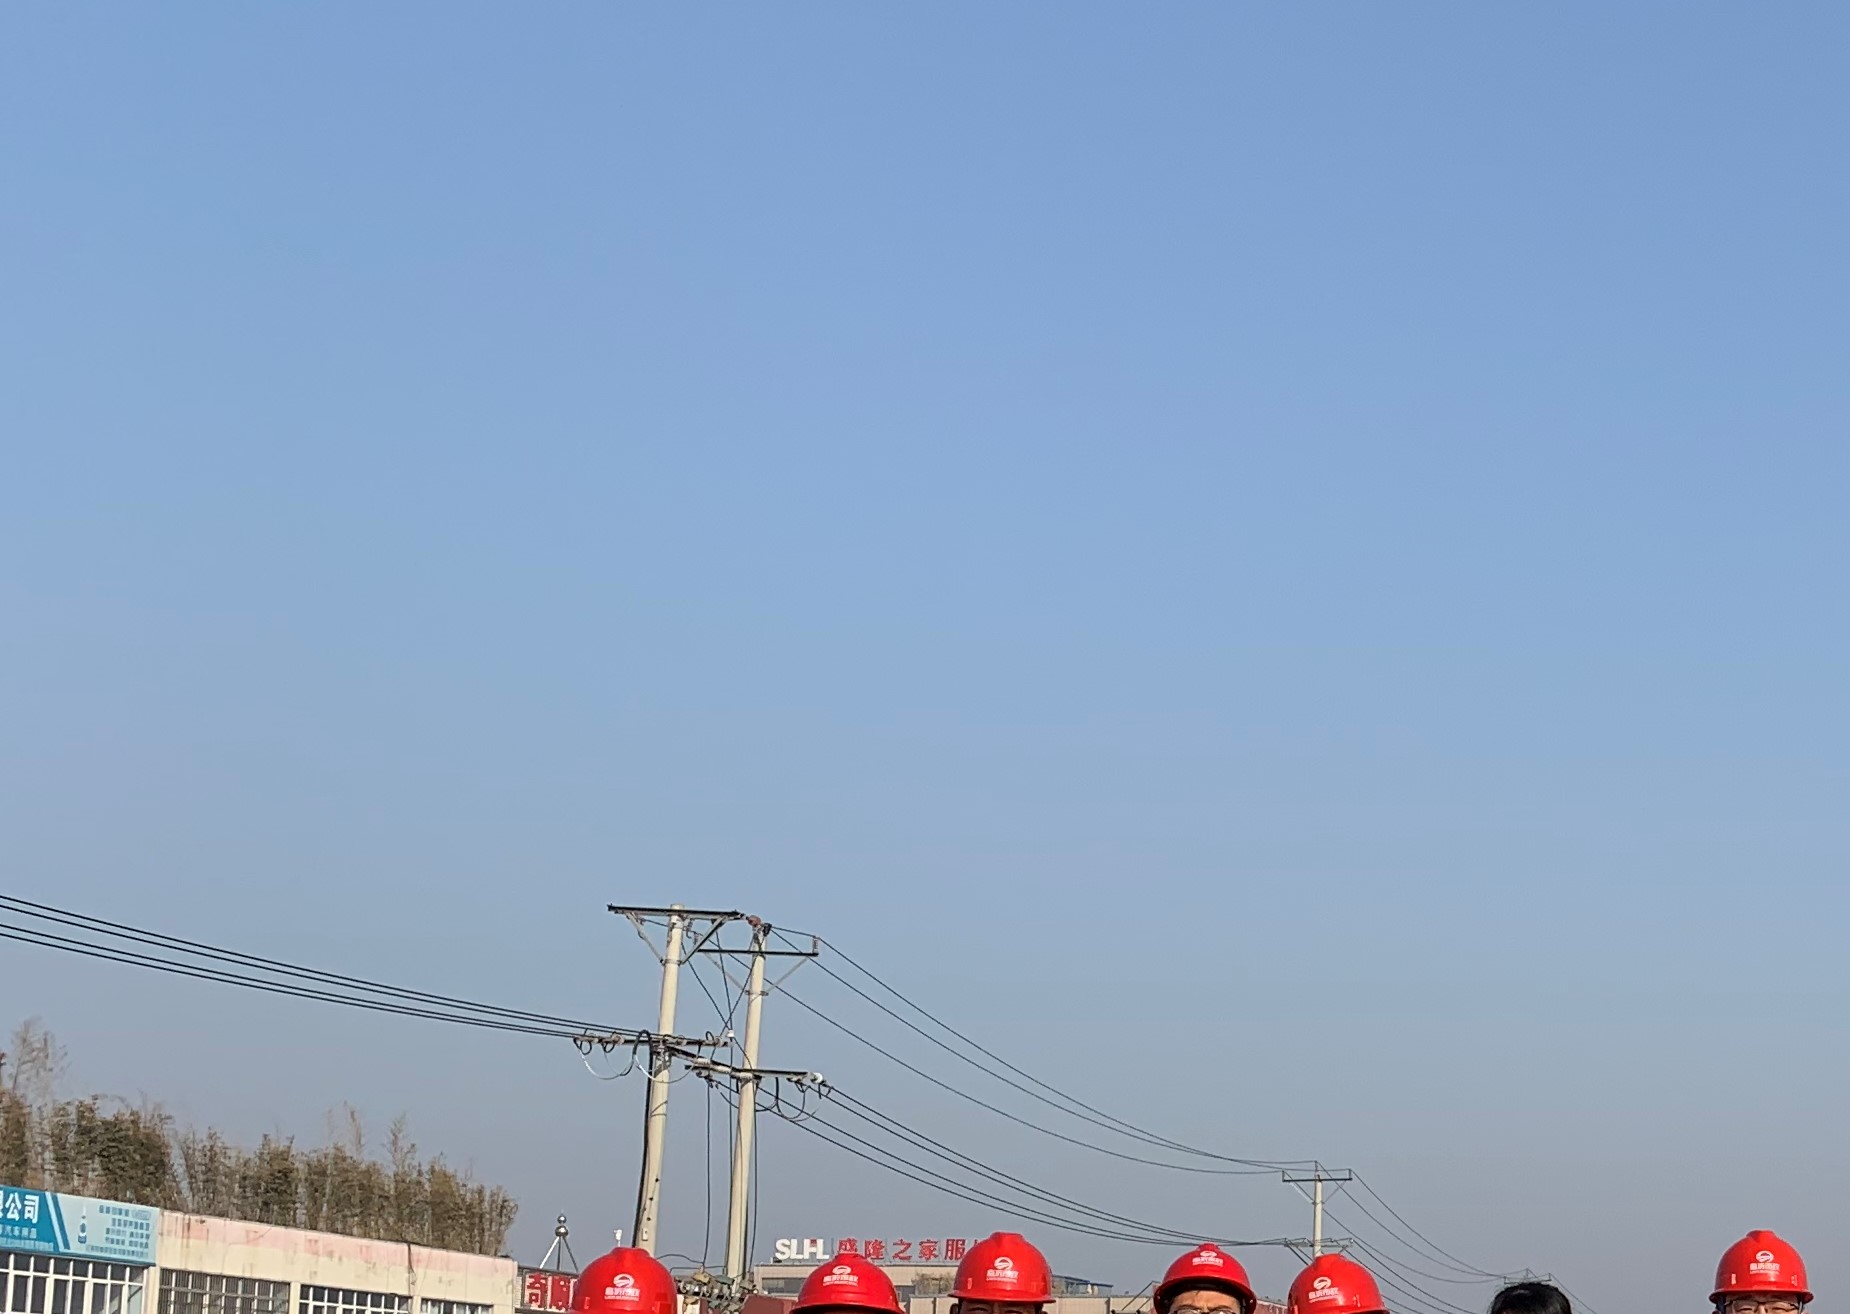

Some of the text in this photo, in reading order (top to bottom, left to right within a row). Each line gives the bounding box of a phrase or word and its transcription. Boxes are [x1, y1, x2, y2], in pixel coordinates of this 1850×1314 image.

[0, 1191, 39, 1223] 公司
[837, 1238, 980, 1261] 盛隆之家服
